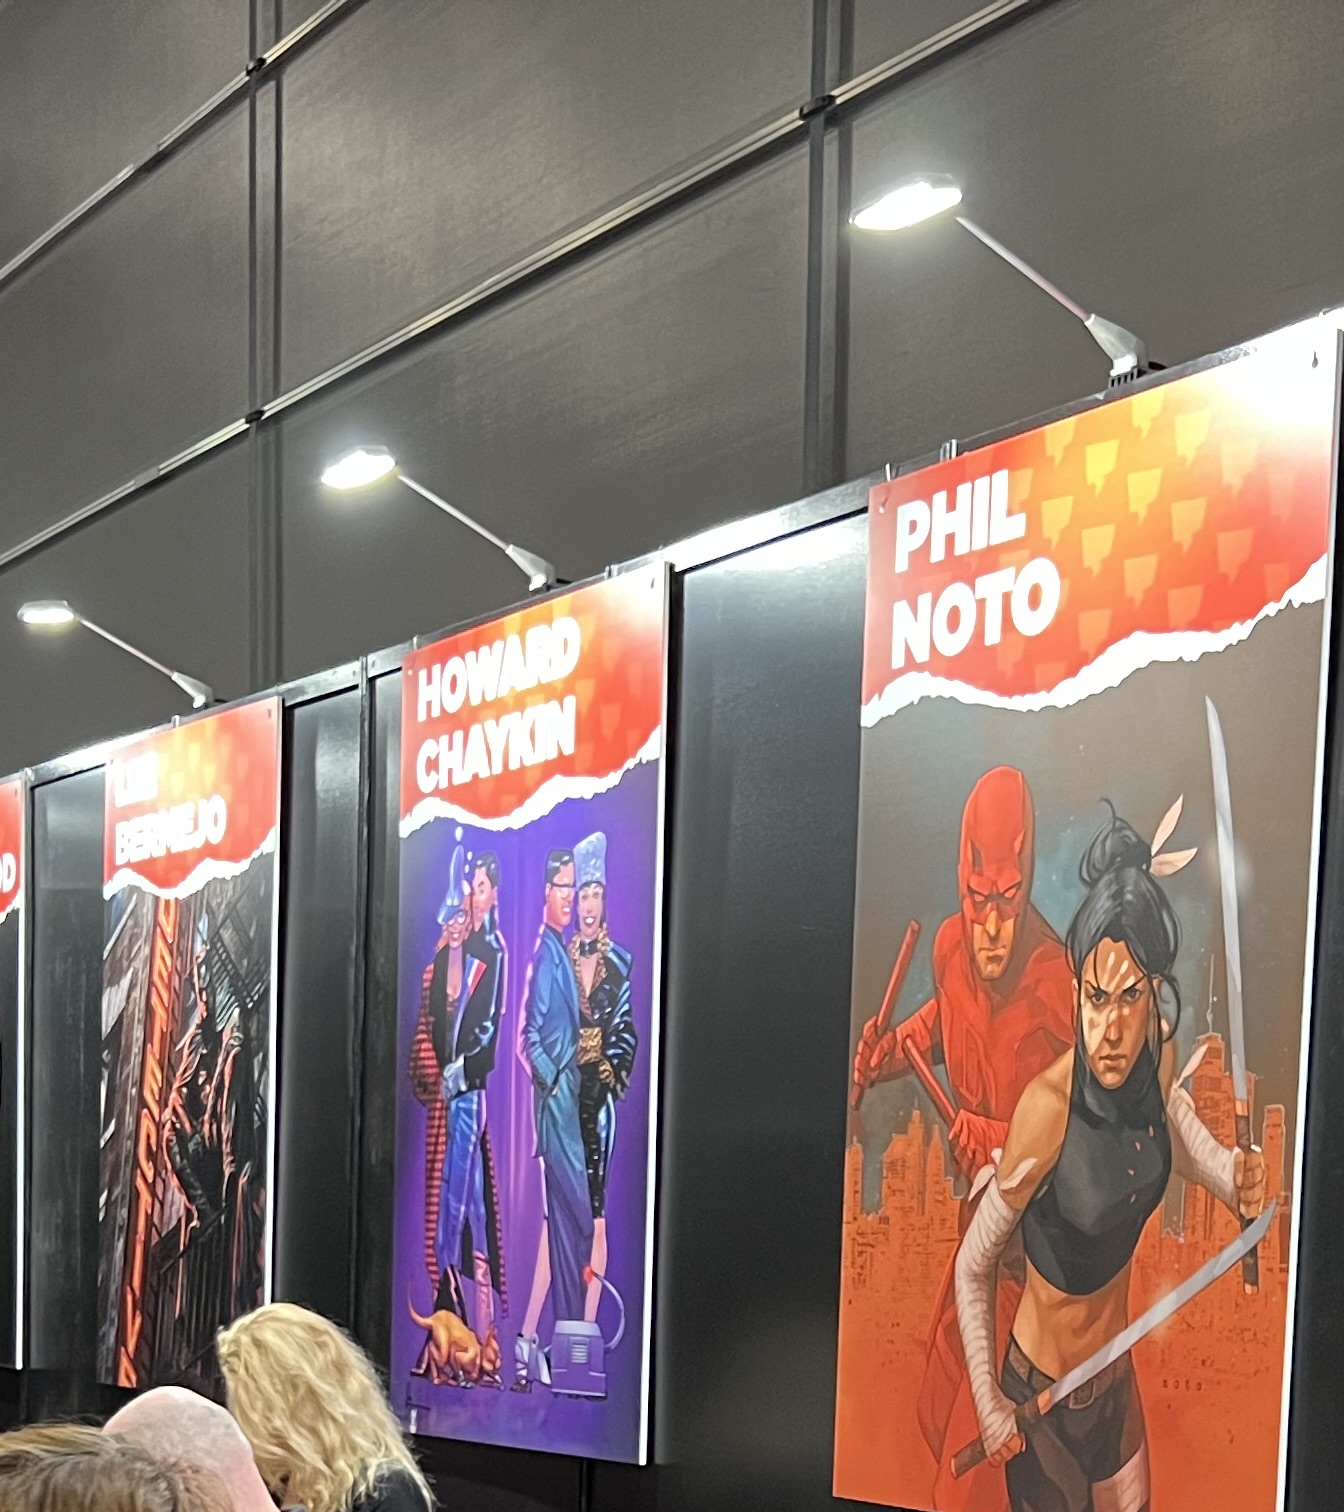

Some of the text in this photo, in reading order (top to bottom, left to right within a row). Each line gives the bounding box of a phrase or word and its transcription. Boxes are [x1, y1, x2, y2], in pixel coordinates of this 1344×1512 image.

[895, 469, 1026, 574] PHIL
[892, 557, 1061, 670] NOTO
[417, 616, 581, 722] HOWARD
[416, 695, 576, 794] CHAYKIN
